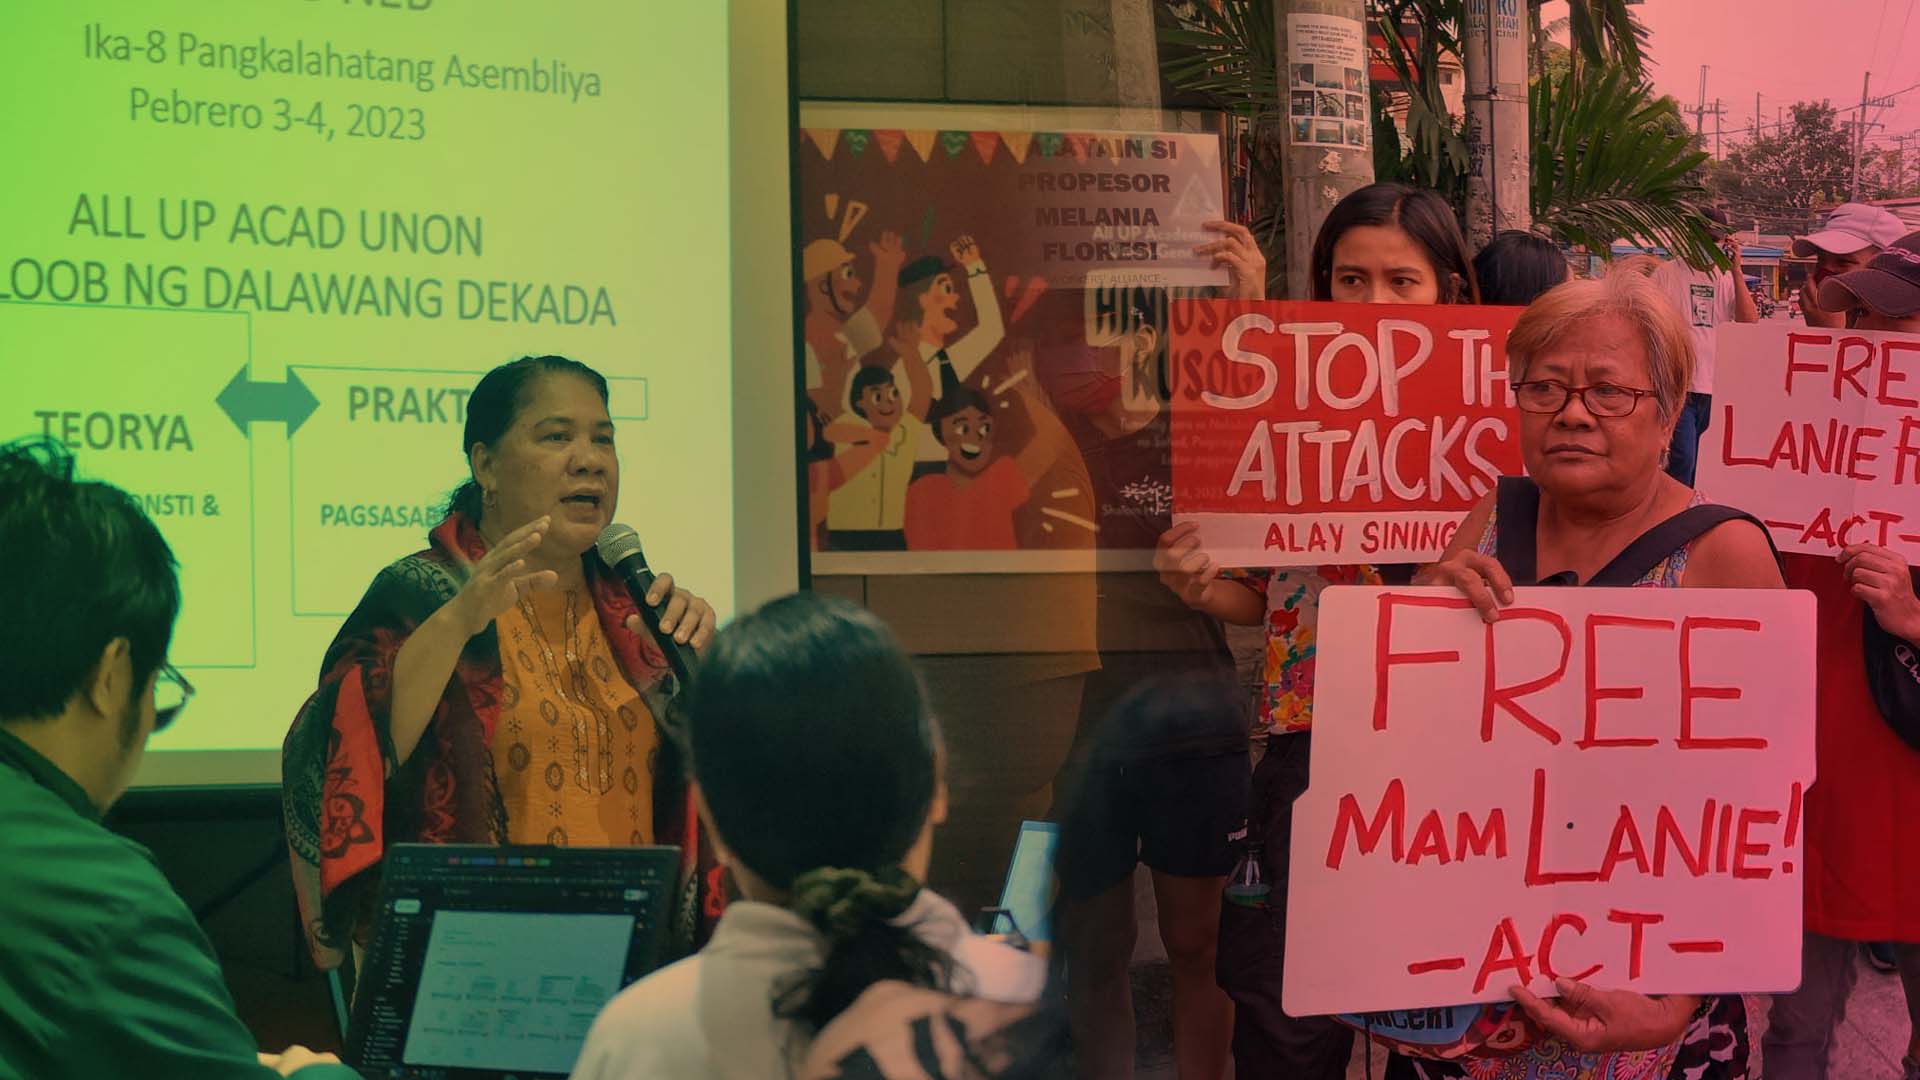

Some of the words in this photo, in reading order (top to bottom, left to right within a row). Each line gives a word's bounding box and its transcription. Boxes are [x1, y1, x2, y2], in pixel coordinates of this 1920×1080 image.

[84, 23, 167, 63] Ika-8
[178, 32, 435, 93] Pangkalahatang
[443, 53, 601, 103] Asembliya
[130, 87, 262, 129] Pebrero
[272, 98, 335, 142] 3-4,
[346, 104, 426, 140] 2023
[1151, 139, 1177, 160] SI
[1017, 172, 1171, 193] PROPESOR
[68, 192, 146, 239] ALL
[159, 198, 216, 241] UP
[228, 203, 345, 249] ACAD
[360, 210, 483, 257] UNON
[1035, 207, 1160, 227] MELANIA
[125, 263, 188, 307] NG
[204, 267, 443, 318] DALAWANG
[459, 279, 617, 326] DEKADA
[1200, 312, 1433, 417] STOP
[33, 410, 195, 452] TEORYA
[1226, 415, 1508, 506] ATTACKS
[1722, 404, 1887, 481] LANIE
[202, 494, 221, 517] &
[1264, 520, 1344, 553] ALAY
[1360, 520, 1459, 554] SINING
[1372, 592, 1768, 750] FREE
[1326, 778, 1507, 870] MAM
[1525, 768, 1802, 887] LANIE!
